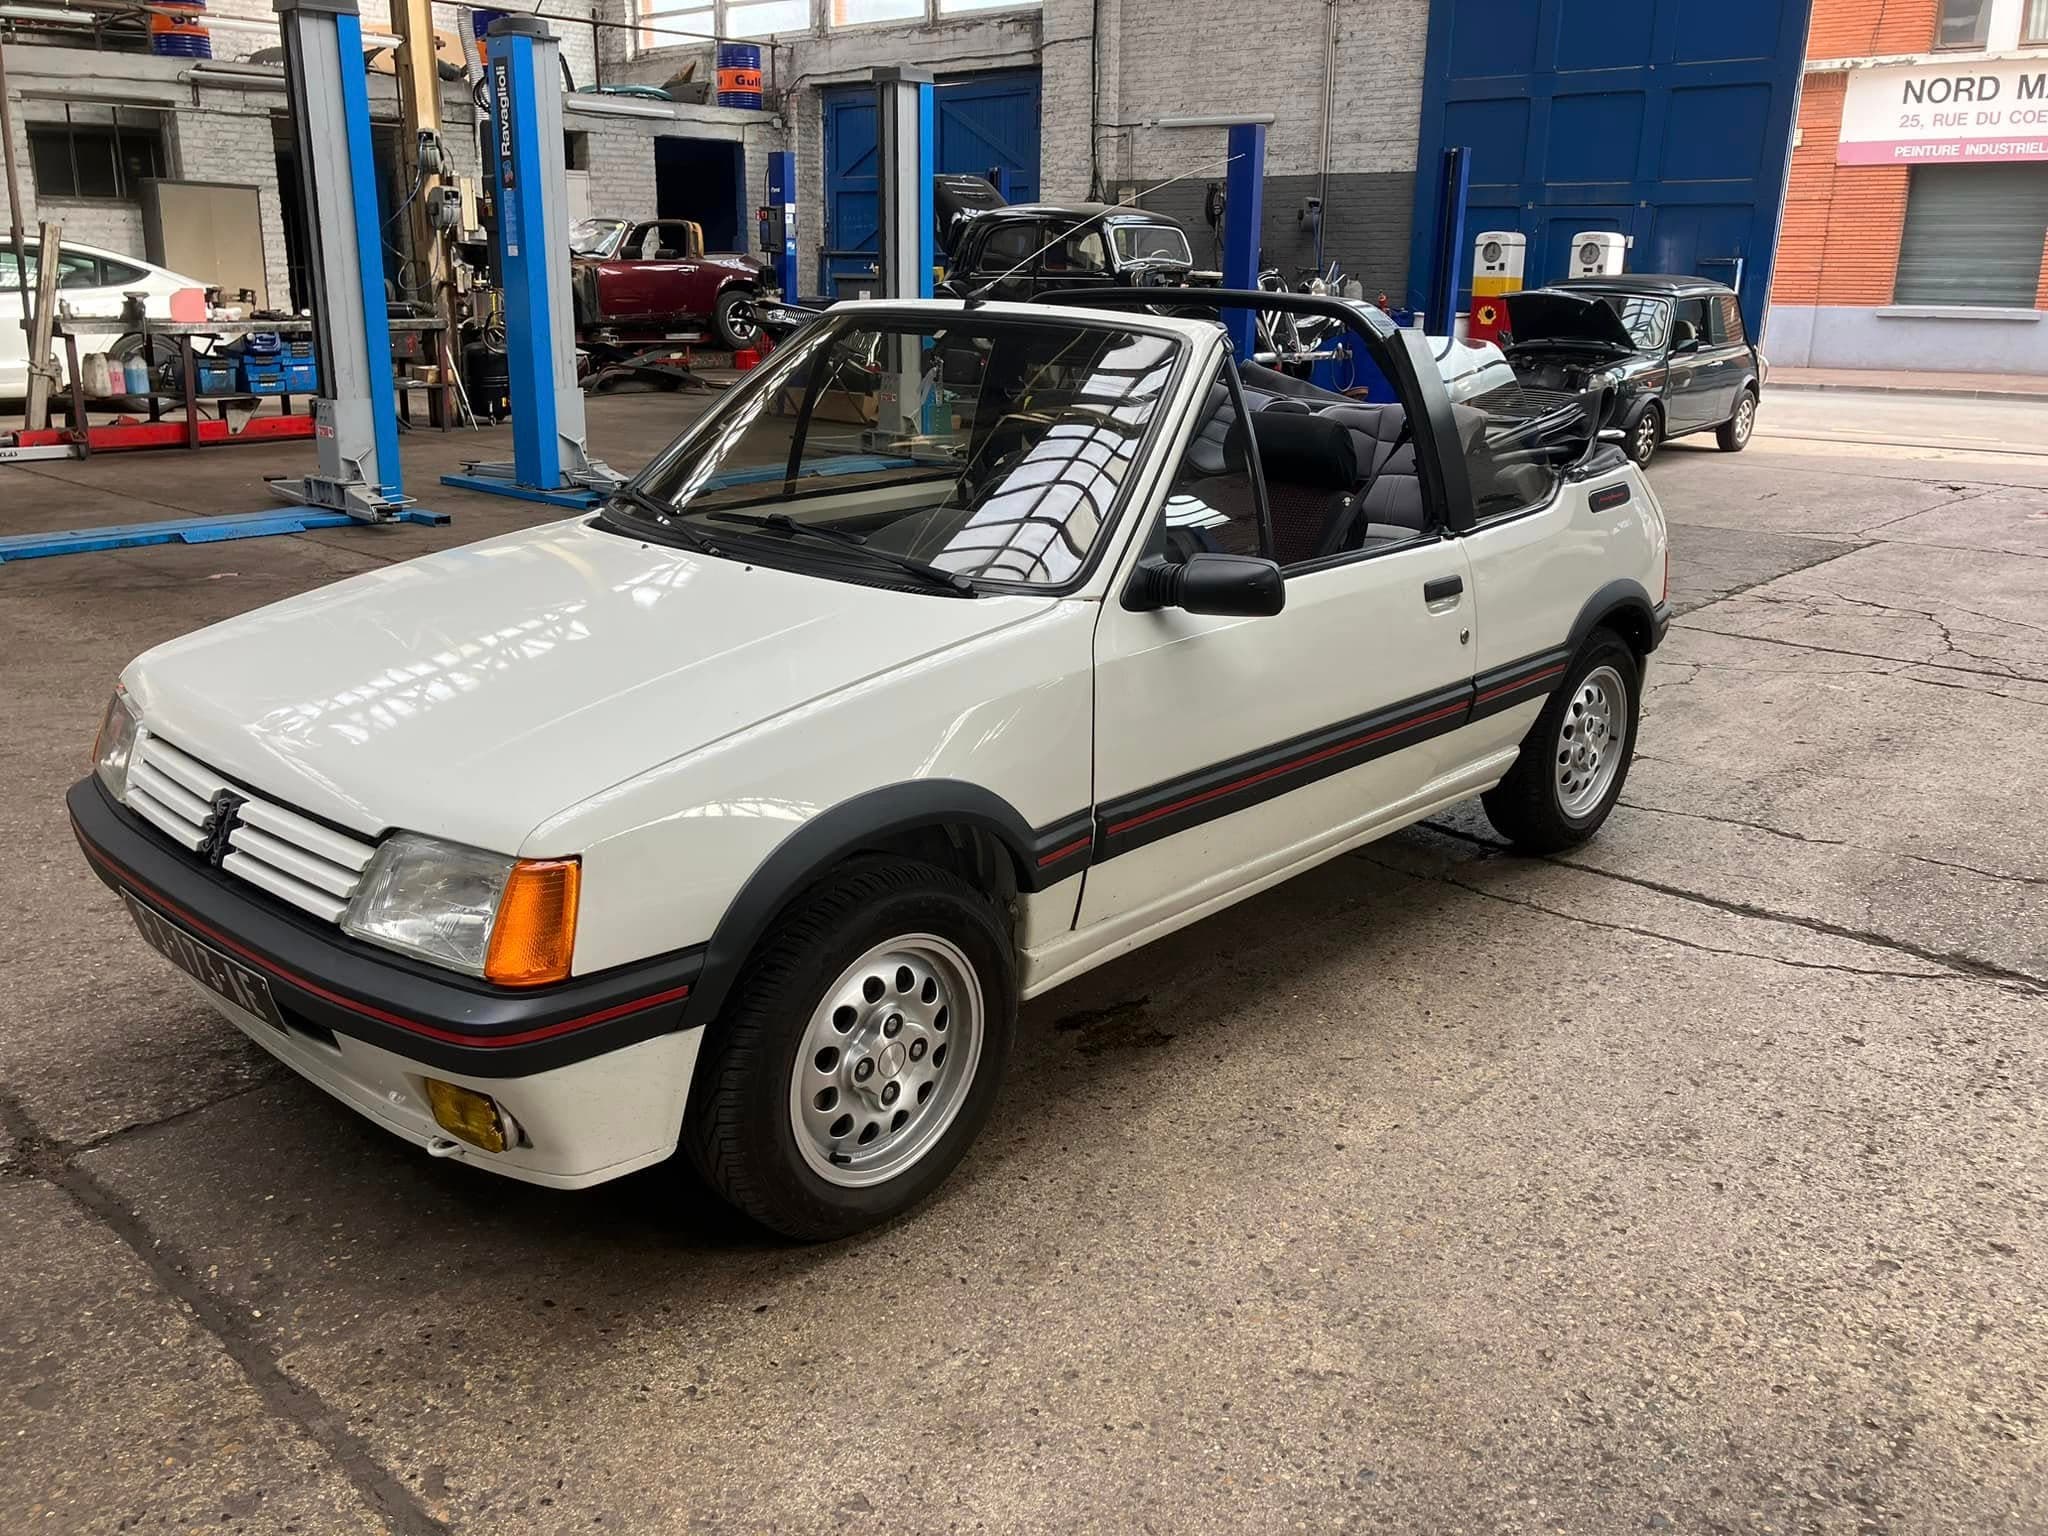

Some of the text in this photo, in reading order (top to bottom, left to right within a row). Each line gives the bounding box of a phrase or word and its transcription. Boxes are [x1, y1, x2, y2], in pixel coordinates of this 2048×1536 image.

[1903, 74, 2048, 104] NORD M
[496, 65, 512, 156] Ravaglioli
[1899, 114, 1925, 130] 25,
[1933, 112, 1969, 127] RUE
[1976, 111, 2001, 125] DU
[1895, 144, 1960, 157] PEINTURE
